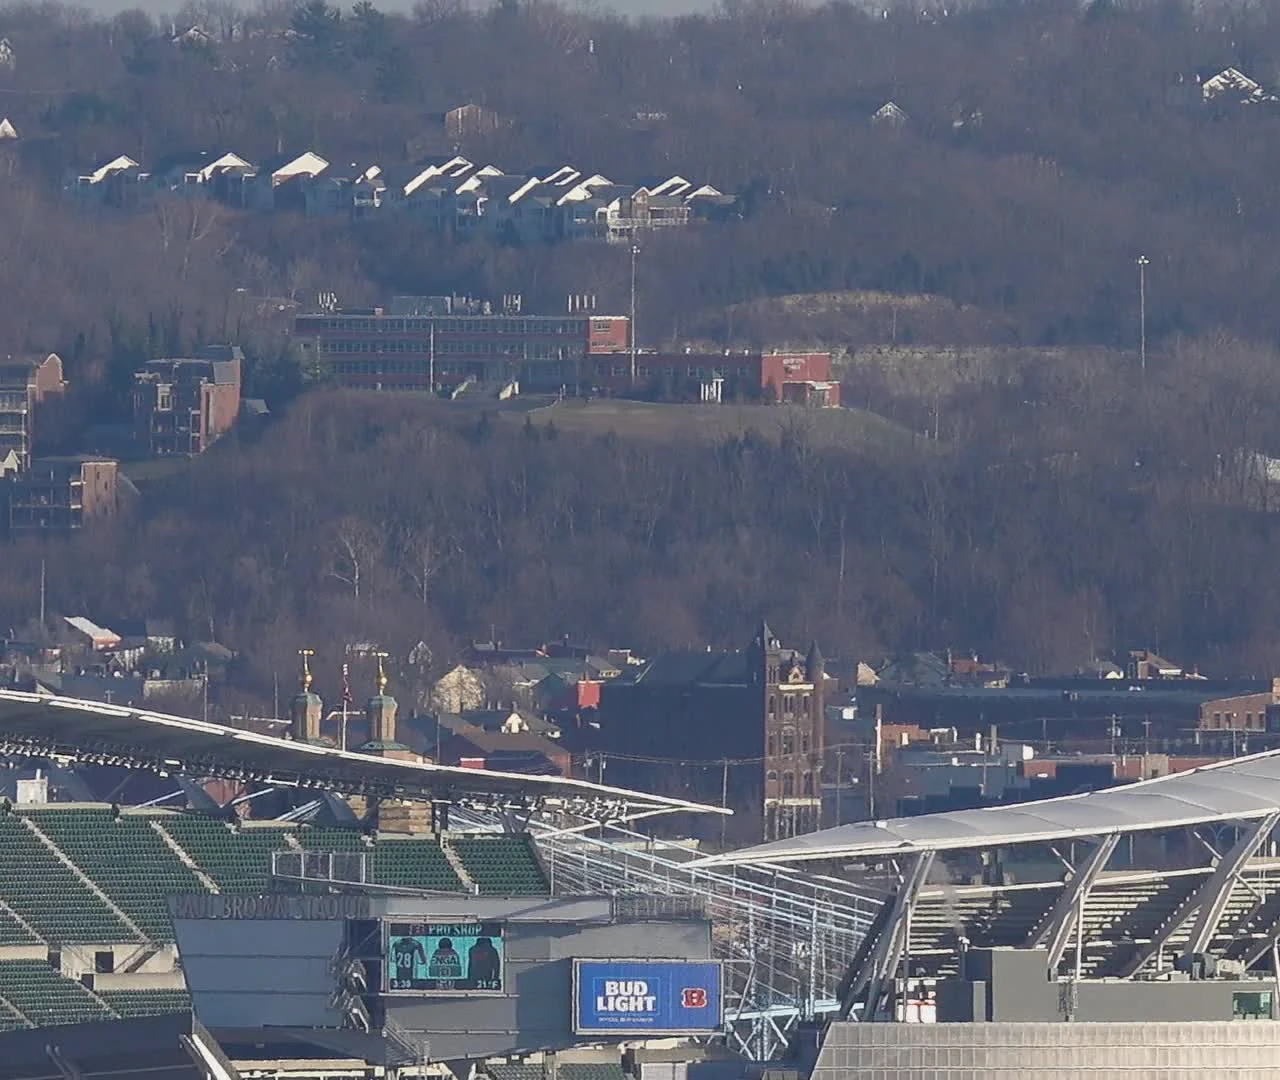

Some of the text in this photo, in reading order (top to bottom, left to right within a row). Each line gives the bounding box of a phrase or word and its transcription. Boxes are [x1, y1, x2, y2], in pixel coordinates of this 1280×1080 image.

[176, 896, 218, 919] PAUL
[223, 896, 288, 919] BROWN
[428, 924, 484, 936] PRO SHOP
[605, 981, 649, 996] BUD
[597, 996, 657, 1011] LIGHT
